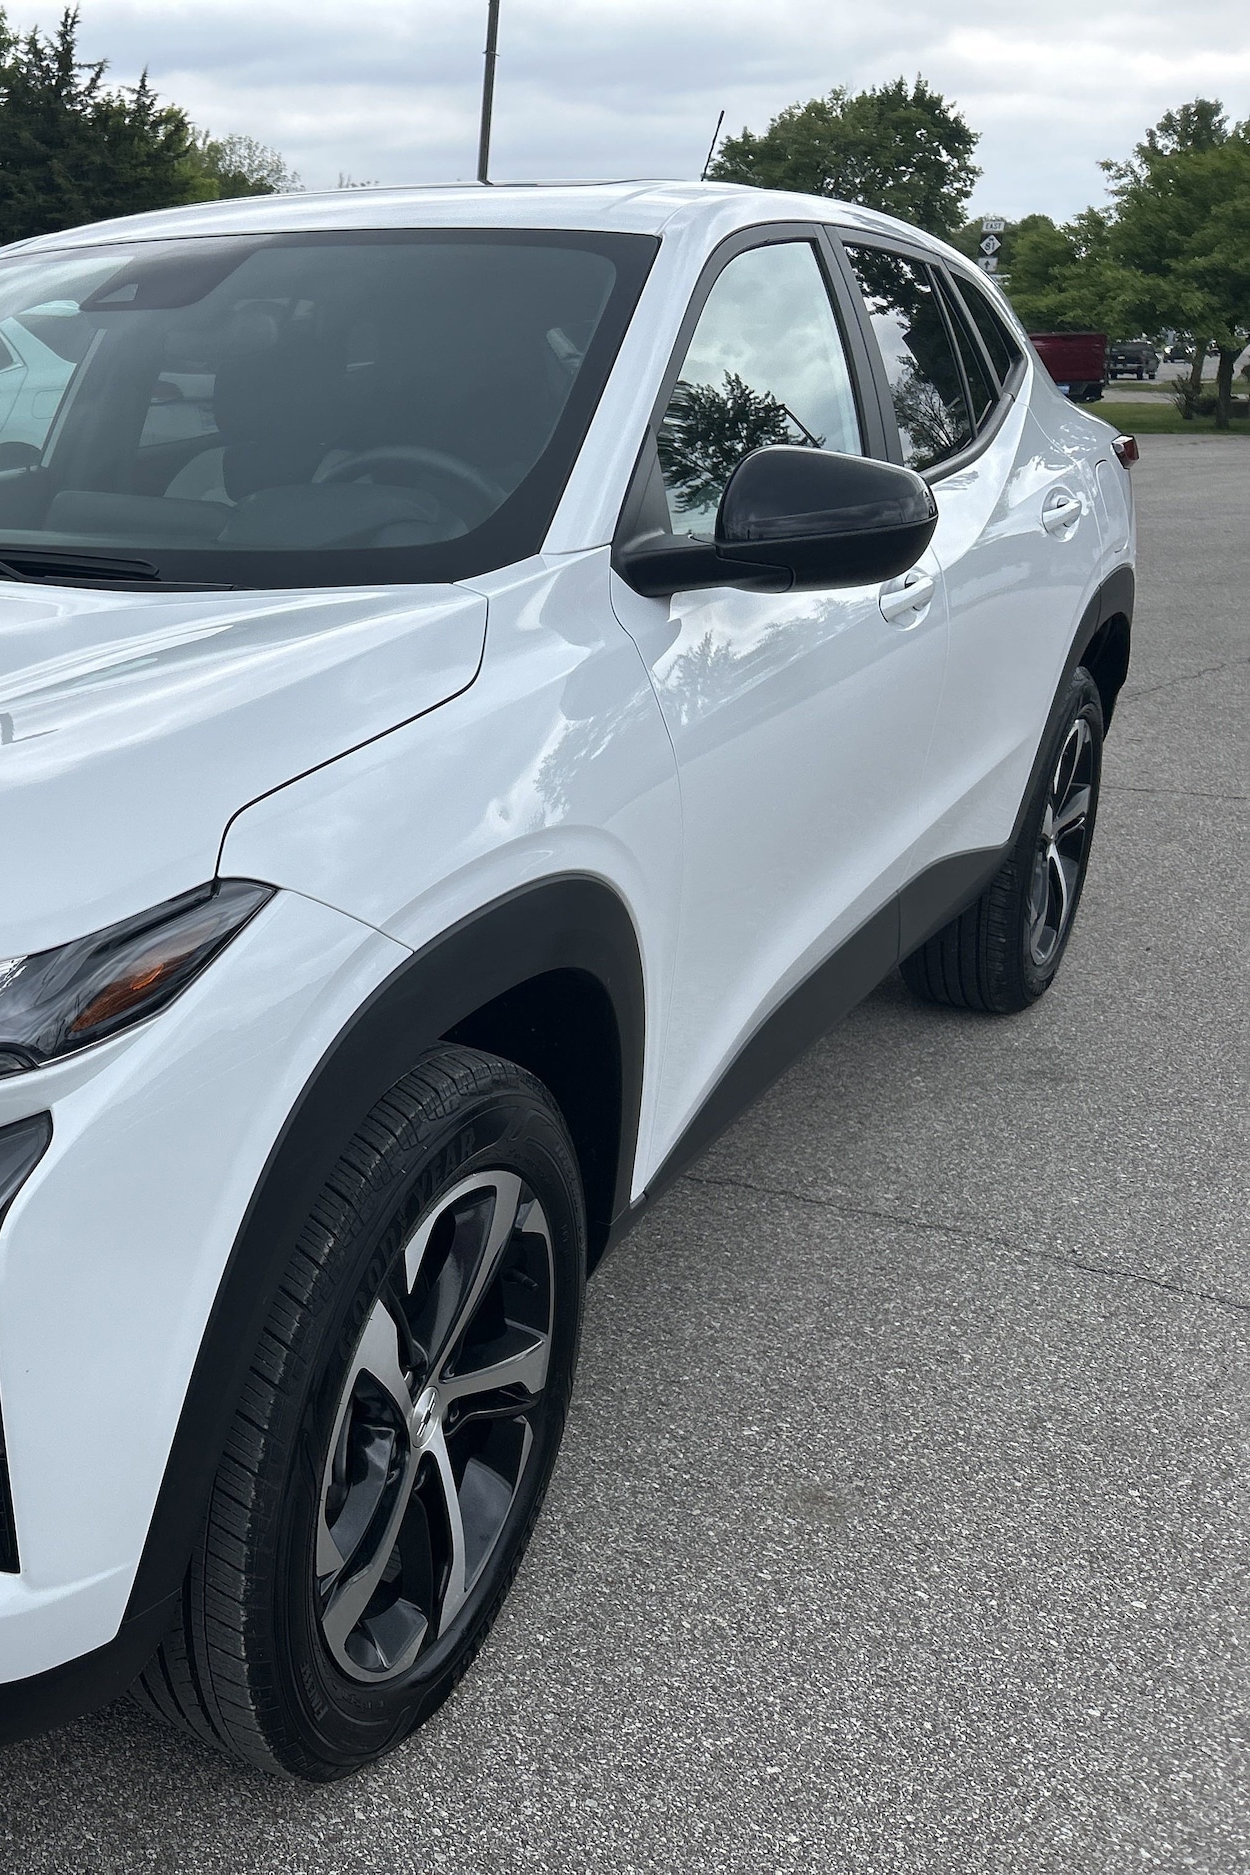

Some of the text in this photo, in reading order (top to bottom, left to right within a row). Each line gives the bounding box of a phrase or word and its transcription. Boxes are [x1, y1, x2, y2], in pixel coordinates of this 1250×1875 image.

[985, 222, 1002, 230] EAST
[984, 242, 996, 251] 81
[337, 1126, 478, 1362] GOODYEAR
